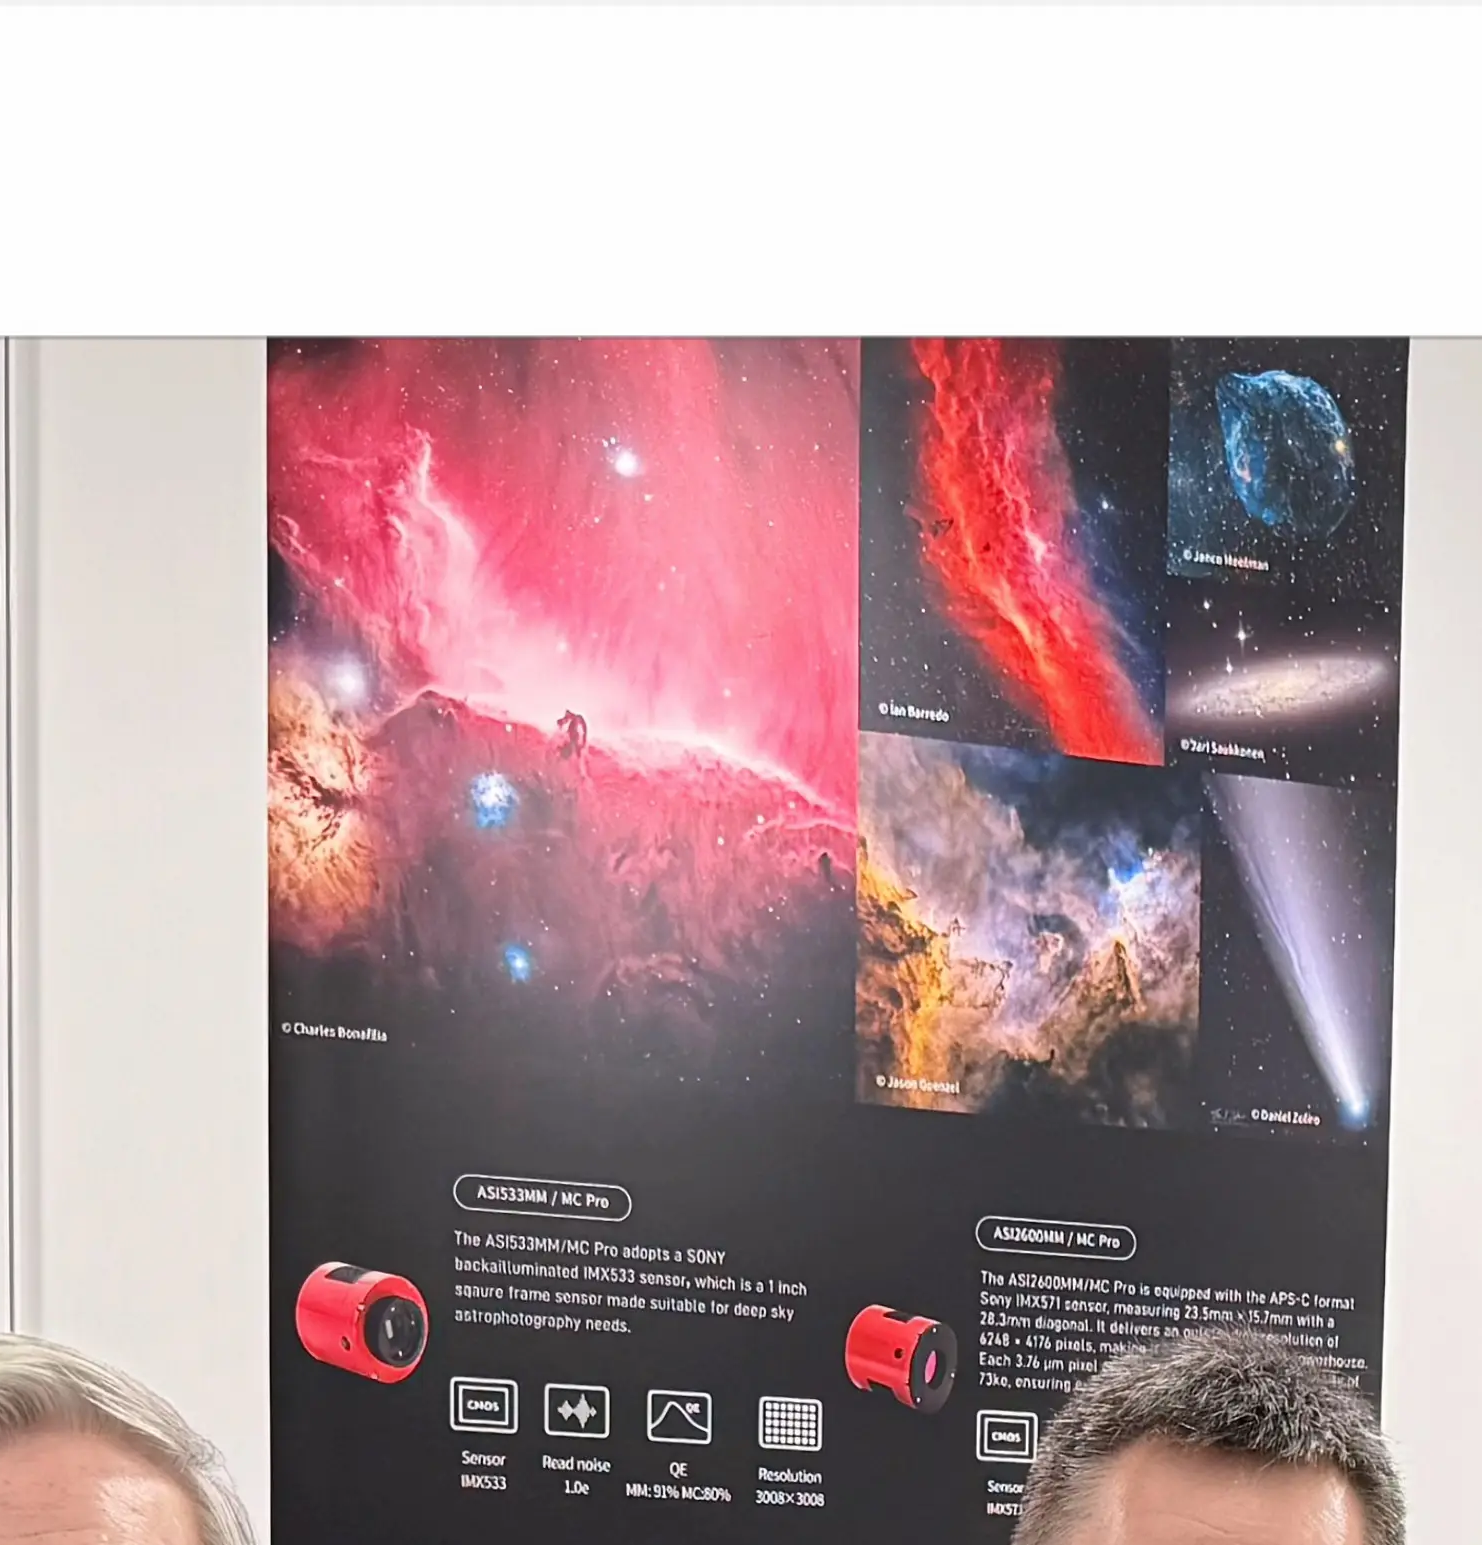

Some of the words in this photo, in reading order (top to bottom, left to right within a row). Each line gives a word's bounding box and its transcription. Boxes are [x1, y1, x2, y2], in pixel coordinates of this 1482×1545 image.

[478, 1186, 547, 1203] ASI533MM
[562, 1192, 581, 1206] MC
[586, 1193, 609, 1208] Pro
[454, 1230, 480, 1246] The
[486, 1234, 589, 1255] ASI533MM/MC
[595, 1242, 618, 1257] Pro
[623, 1245, 670, 1261] adopts
[687, 1249, 725, 1264] SONY
[1099, 1234, 1120, 1248] Pro
[584, 1266, 634, 1283] IMX533
[640, 1273, 690, 1289] sensor,
[694, 1276, 735, 1290] which
[779, 1280, 806, 1295] inch
[981, 1270, 1004, 1286] The
[1114, 1280, 1135, 1295] Pro
[1154, 1286, 1210, 1301] equipped
[1215, 1289, 1241, 1302] with
[1270, 1292, 1309, 1307] APS-C
[1314, 1295, 1354, 1310] format
[509, 1286, 550, 1302] frame
[555, 1292, 602, 1305] sensor
[607, 1294, 645, 1308] made
[650, 1298, 705, 1313] suitable
[734, 1303, 766, 1319] deep
[771, 1305, 794, 1321] sky
[1017, 1294, 1060, 1310] IMX571
[1114, 1303, 1180, 1321] measuring
[1297, 1315, 1323, 1327] with
[455, 1310, 581, 1331] astrophotography
[586, 1319, 631, 1333] needs.
[980, 1311, 1030, 1328] 28.3mm
[1035, 1316, 1093, 1332] diagonal.
[1110, 1321, 1160, 1337] delivers
[1056, 1338, 1096, 1353] pixels,
[979, 1352, 1011, 1366] Each
[1016, 1378, 1071, 1393] ensuring
[462, 1450, 506, 1466] Sensor
[543, 1455, 574, 1470] Read
[577, 1458, 611, 1472] noise
[461, 1475, 506, 1489] IMX533
[759, 1467, 822, 1483] Resolution
